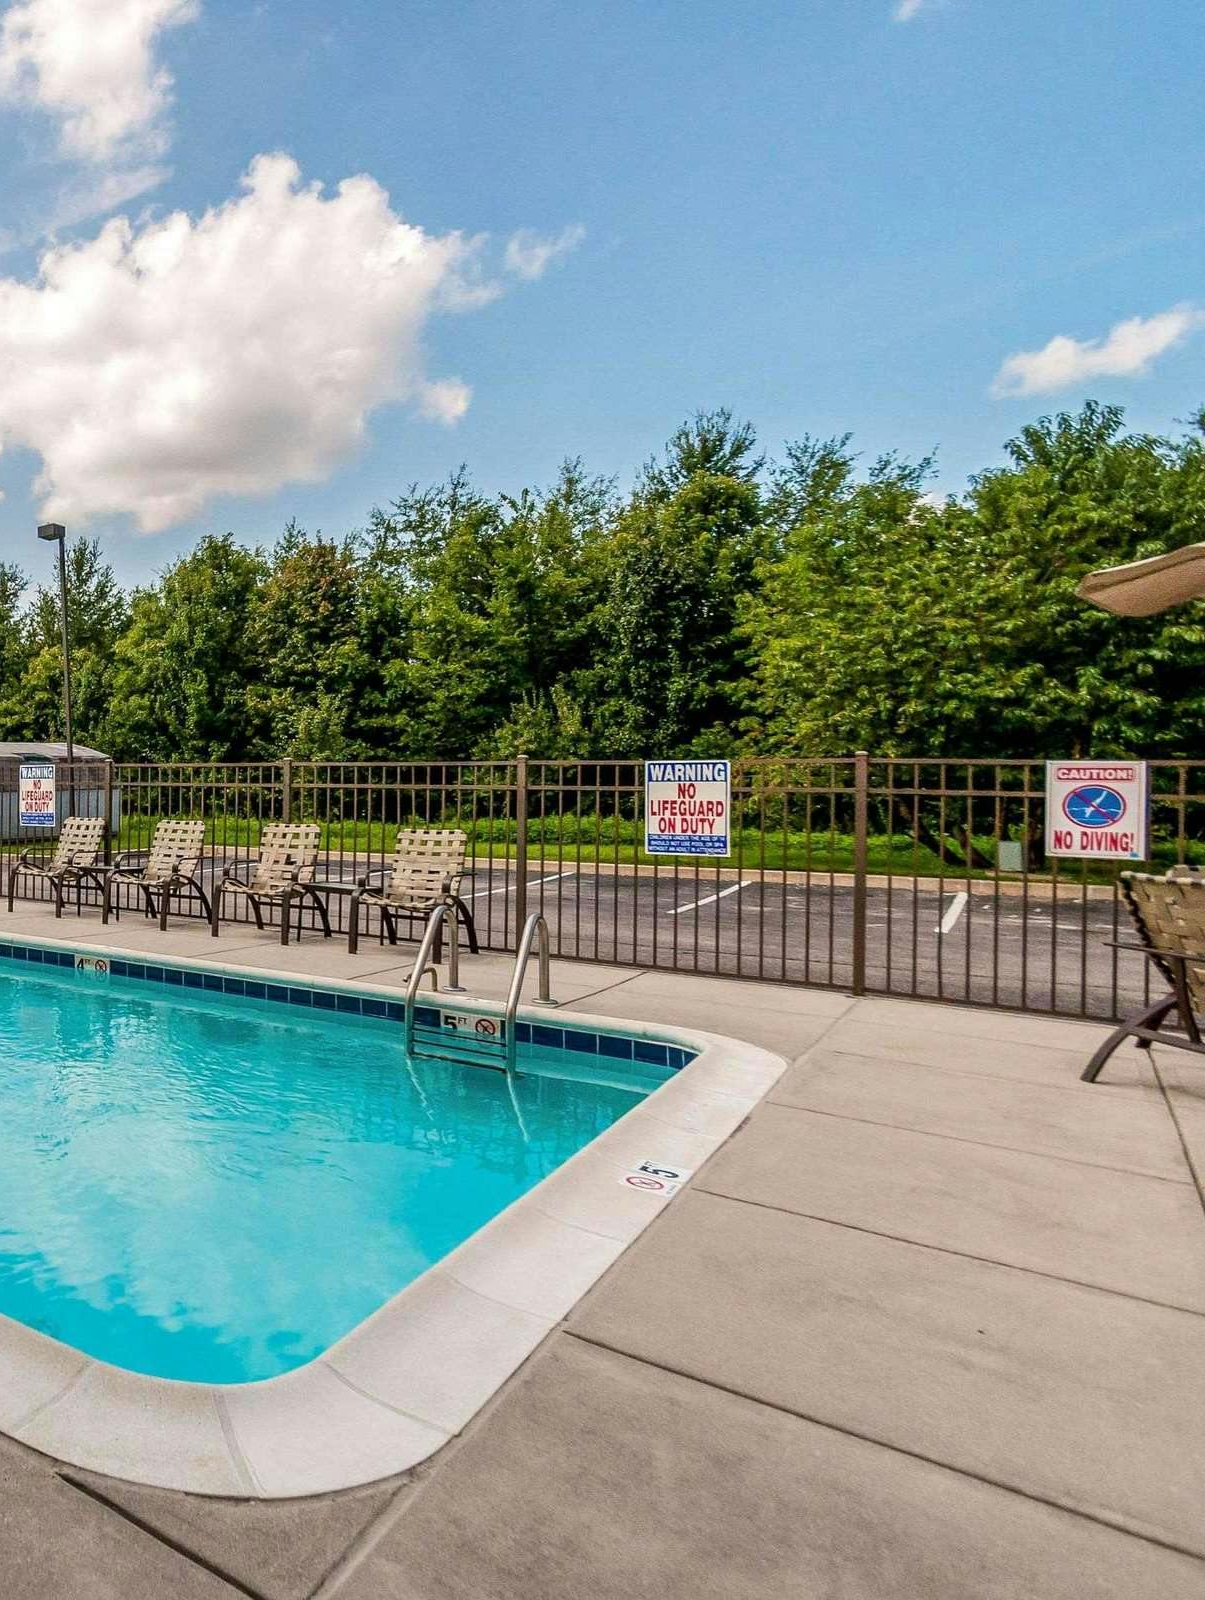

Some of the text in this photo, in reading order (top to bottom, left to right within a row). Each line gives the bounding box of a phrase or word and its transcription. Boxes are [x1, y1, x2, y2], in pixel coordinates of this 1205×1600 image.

[21, 767, 53, 778] WARNING
[650, 763, 726, 781] WARNING
[1058, 769, 1133, 780] CAUTION!
[22, 791, 53, 801] LIFEGUARD
[677, 783, 696, 799] NO
[651, 800, 724, 817] LIFEGUARD
[658, 817, 715, 834] ON DUTY
[1053, 830, 1134, 852] NO DIVING!
